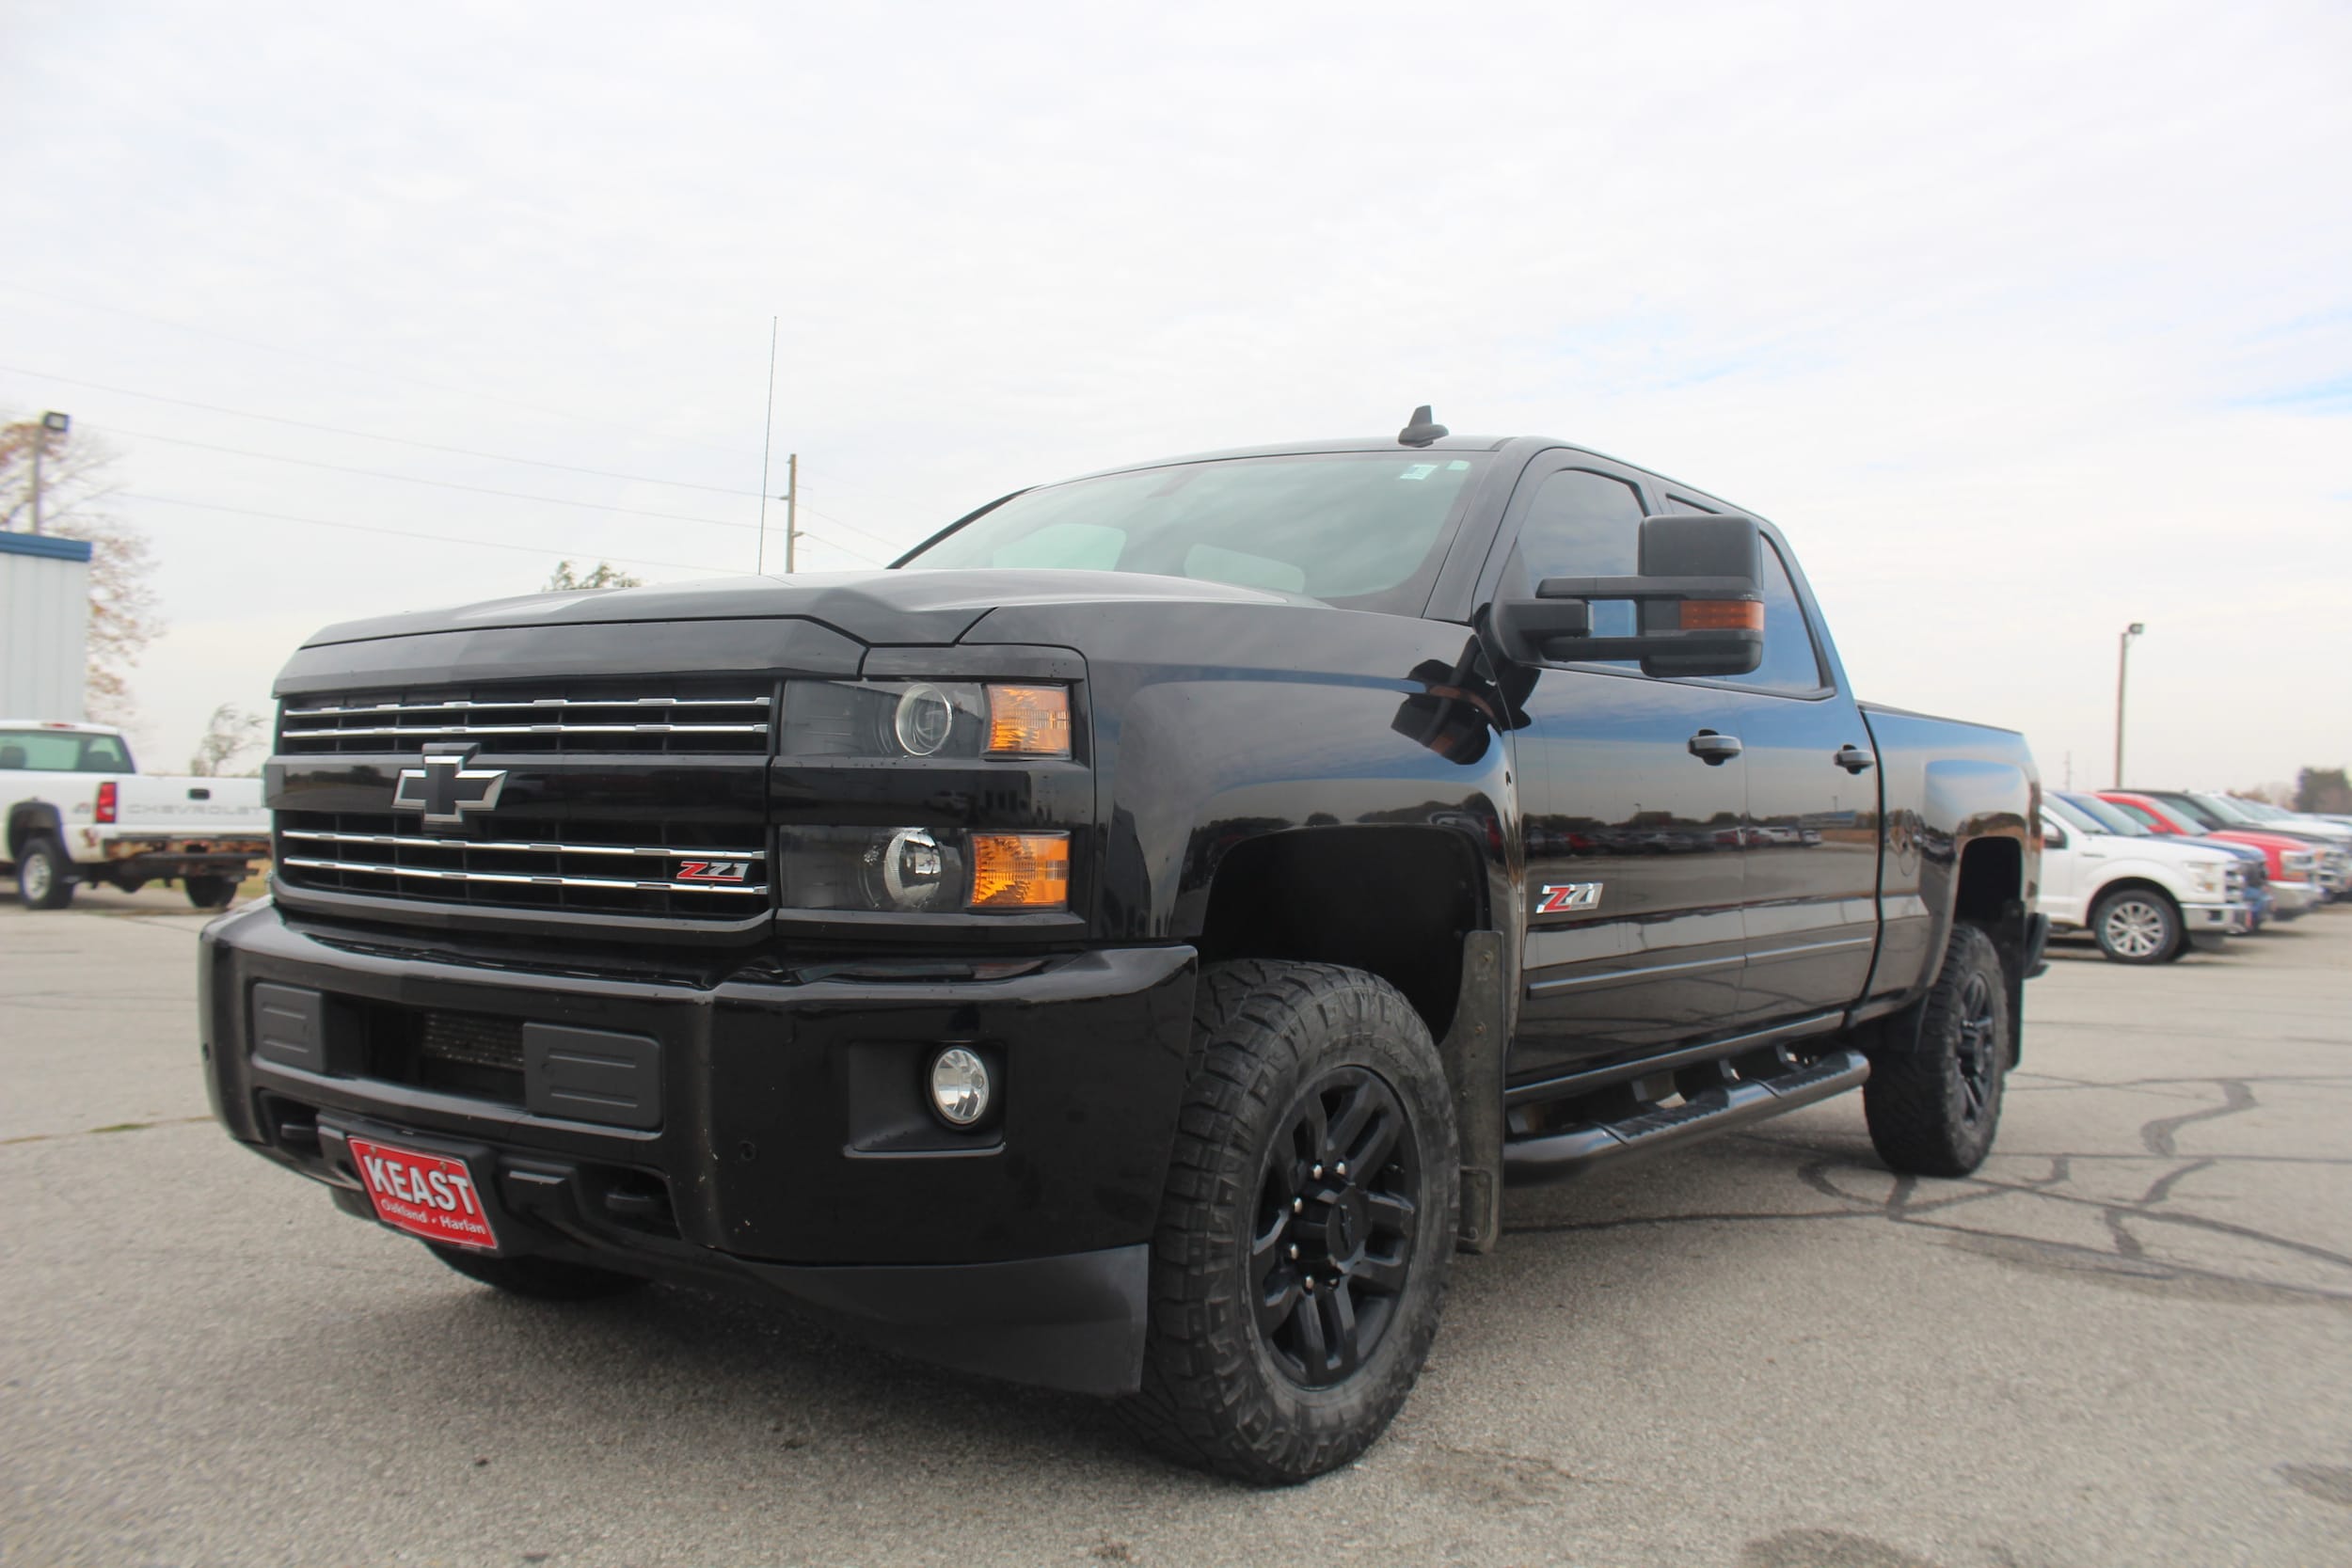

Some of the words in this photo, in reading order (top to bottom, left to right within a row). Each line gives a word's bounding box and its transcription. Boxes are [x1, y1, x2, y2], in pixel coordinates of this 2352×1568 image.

[127, 803, 262, 816] CHEVROLET
[676, 861, 750, 882] Z71
[1535, 882, 1603, 913] Z71
[363, 1155, 474, 1215] KEAST
[381, 1198, 428, 1224] Oakland
[439, 1215, 486, 1235] Harlan
